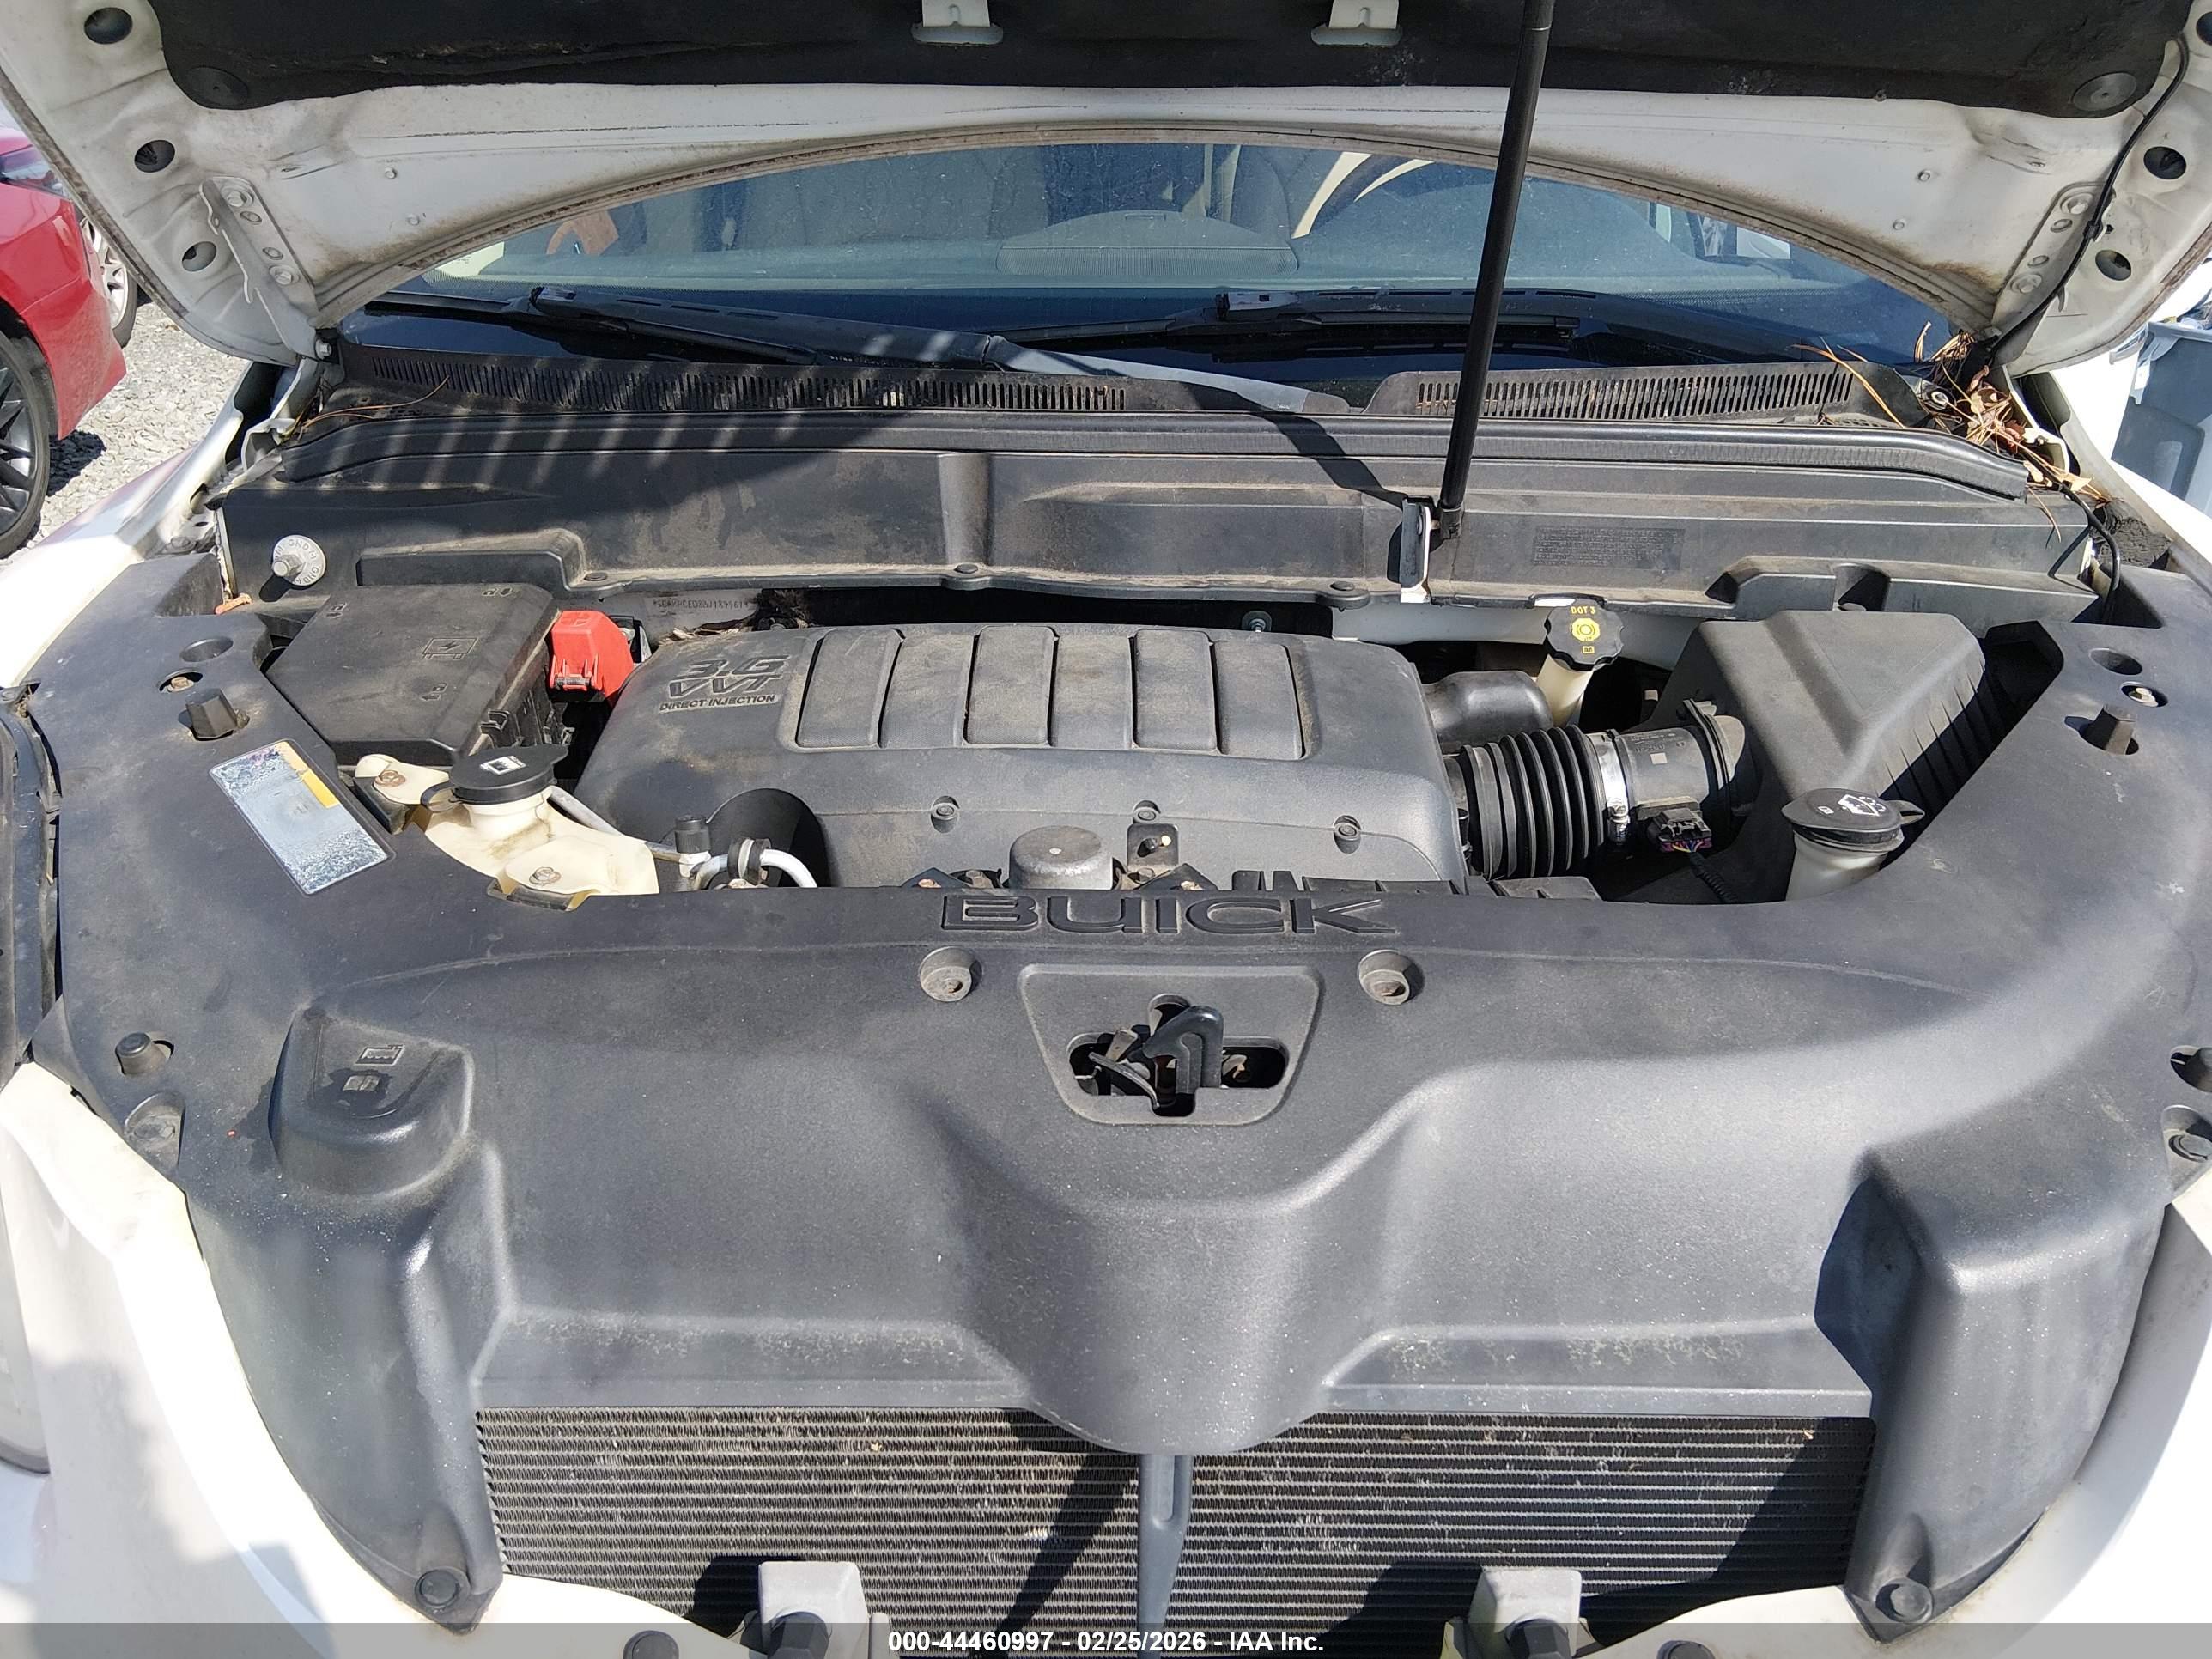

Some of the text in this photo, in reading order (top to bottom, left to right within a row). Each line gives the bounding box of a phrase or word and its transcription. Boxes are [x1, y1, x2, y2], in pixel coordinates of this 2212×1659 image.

[1570, 605, 1596, 615] DOT 3
[676, 654, 791, 679] 3.6
[668, 673, 784, 699] VVT
[659, 694, 776, 713] DIRECT INJECTION
[942, 895, 1398, 935] BUICK
